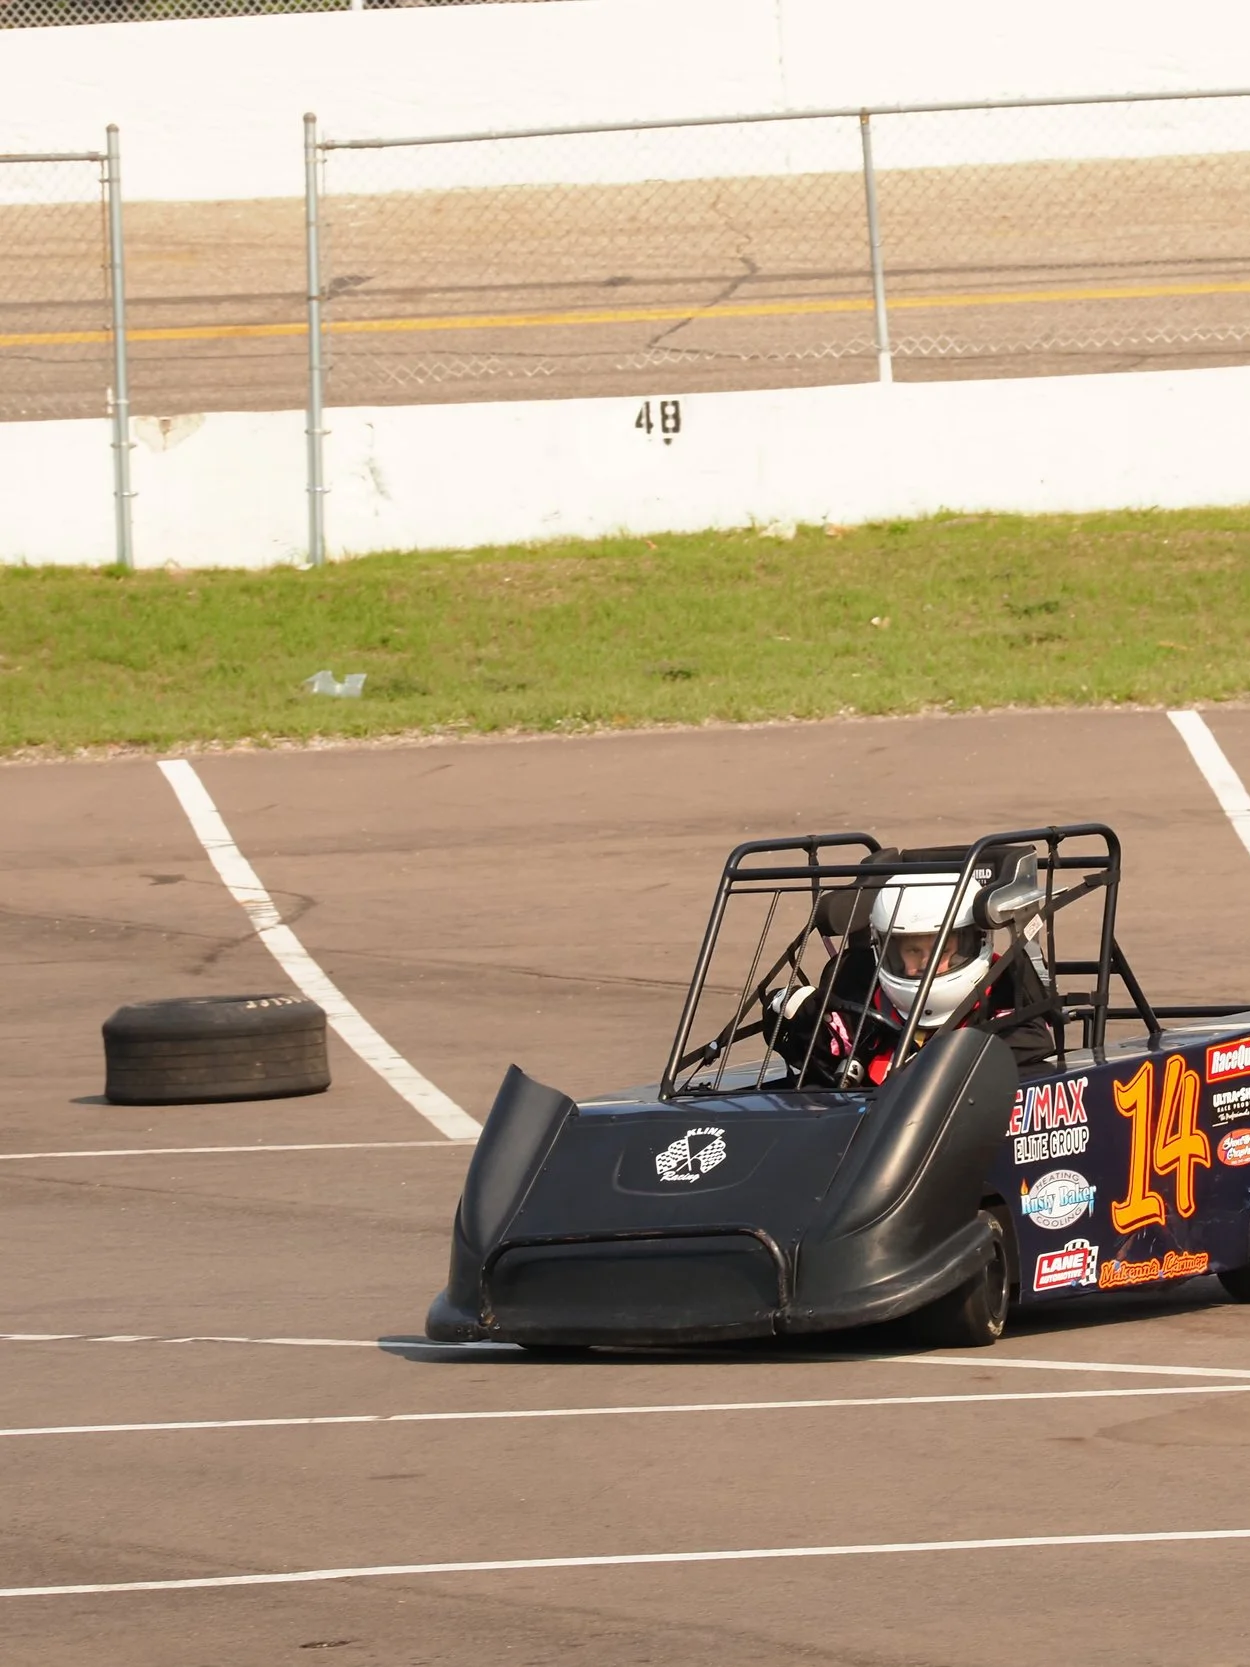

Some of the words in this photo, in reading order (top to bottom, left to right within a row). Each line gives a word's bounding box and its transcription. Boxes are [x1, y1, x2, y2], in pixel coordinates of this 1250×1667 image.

[635, 400, 681, 434] 48
[1005, 1077, 1089, 1136] E/MAX
[1014, 1132, 1049, 1164] ELITE
[1050, 1126, 1089, 1158] GROUP
[1112, 1054, 1211, 1234] 14
[660, 1170, 700, 1183] Racing
[1035, 1171, 1080, 1191] HEATING
[1021, 1190, 1056, 1215] Rusty
[1059, 1184, 1097, 1207] Baker
[1036, 1207, 1083, 1227] COOLING
[1041, 1252, 1084, 1275] LANE
[1099, 1257, 1161, 1289] Makenna
